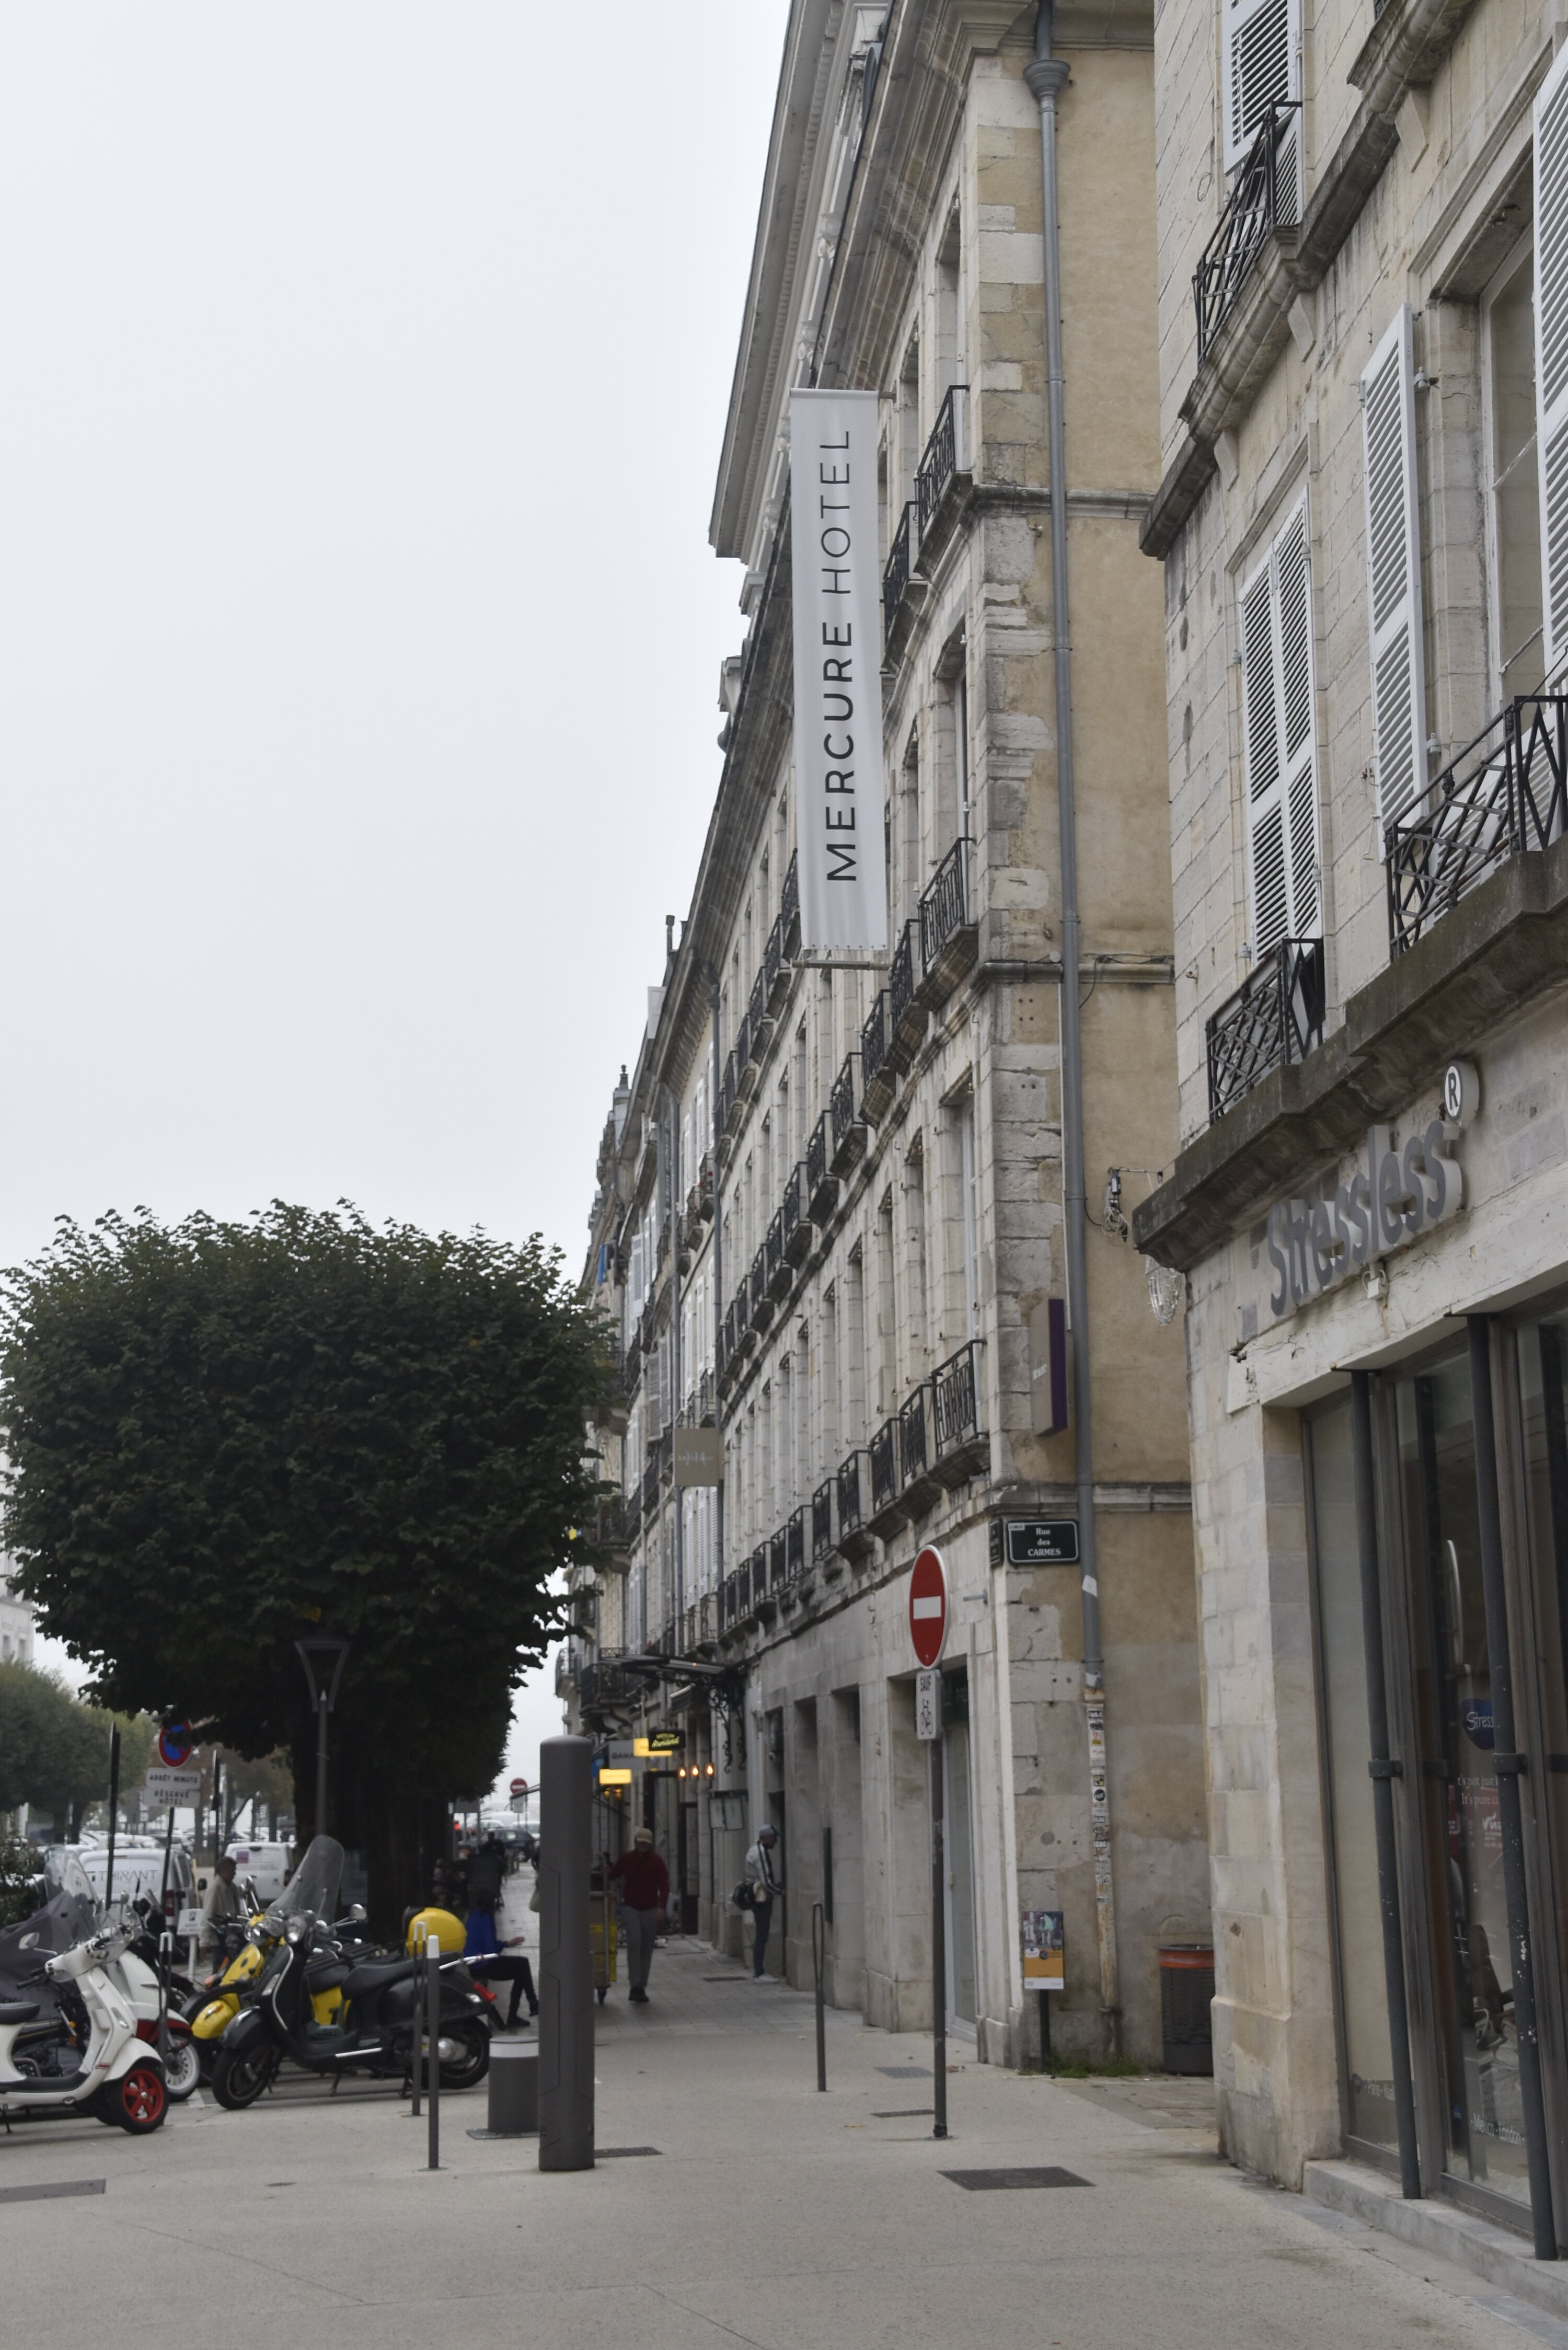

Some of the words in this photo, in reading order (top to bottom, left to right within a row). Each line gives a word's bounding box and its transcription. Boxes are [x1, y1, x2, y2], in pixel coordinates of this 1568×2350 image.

[819, 429, 851, 596] HOTEL
[823, 621, 858, 882] MERCURE
[1267, 1120, 1456, 1317] Stressless
[1028, 1548, 1061, 1556] CARMES
[920, 1675, 931, 1692] SAUF
[651, 1735, 679, 1748] Armand
